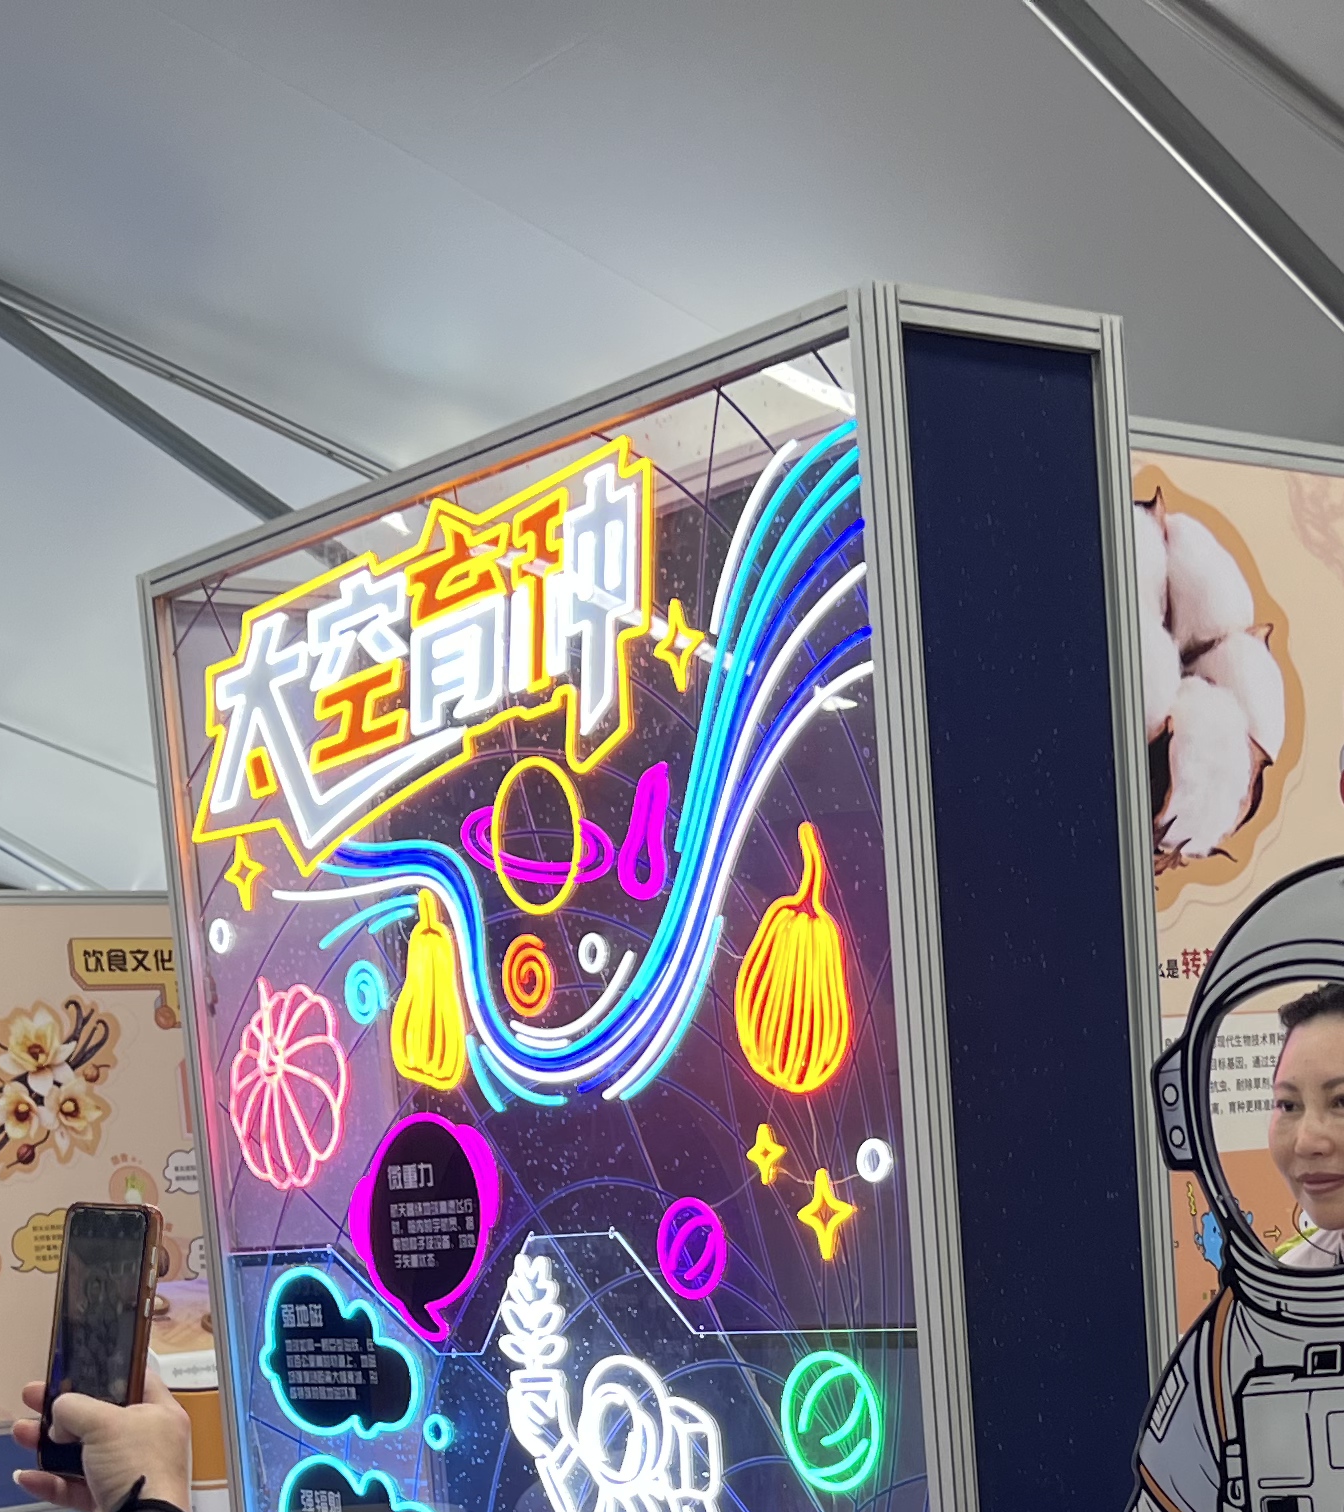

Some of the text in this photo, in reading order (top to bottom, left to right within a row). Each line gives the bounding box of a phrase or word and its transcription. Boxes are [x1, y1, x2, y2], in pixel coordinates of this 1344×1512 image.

[210, 462, 638, 850] 太空育种
[83, 947, 175, 974] 饮食文化
[1158, 948, 1214, 980] 么是转
[387, 1162, 435, 1191] 微重力
[280, 1303, 324, 1329] 弱地磁
